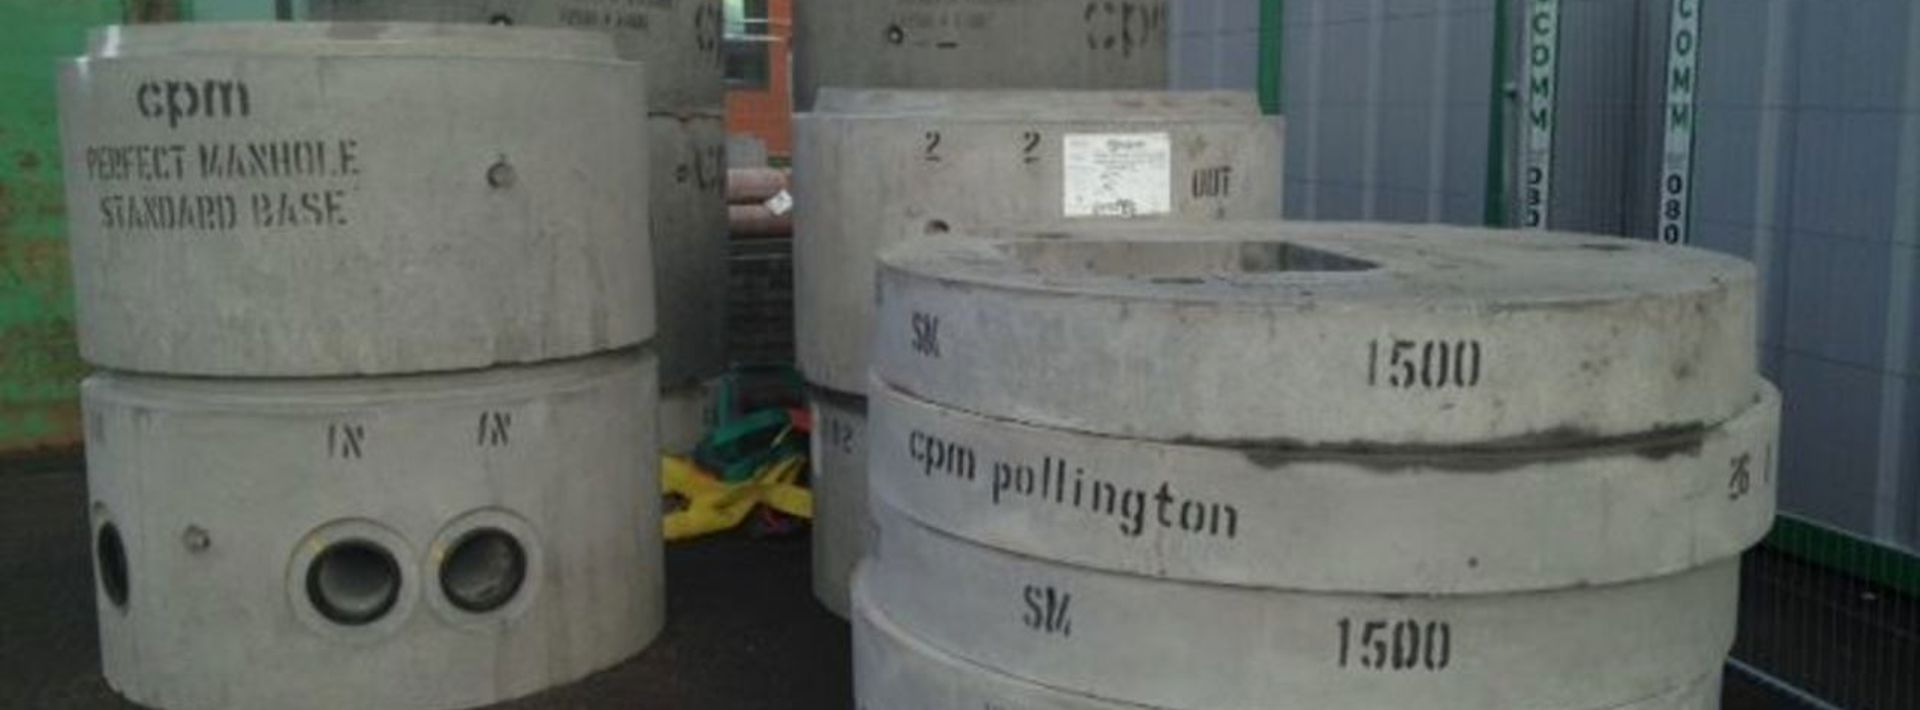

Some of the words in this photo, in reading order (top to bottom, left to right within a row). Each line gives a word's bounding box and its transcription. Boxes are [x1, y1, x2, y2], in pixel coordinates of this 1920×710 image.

[1530, 0, 1551, 131] COMM
[137, 80, 250, 129] cpm
[86, 145, 186, 181] PERFECT
[198, 140, 361, 179] MANHOLE
[100, 195, 237, 230] STANDARD
[252, 189, 349, 228] BASE
[1664, 173, 1684, 245] 080
[1366, 338, 1482, 390] 1500
[908, 427, 977, 482] cpm
[991, 455, 1239, 540] pollington
[1336, 616, 1452, 671] 1500
